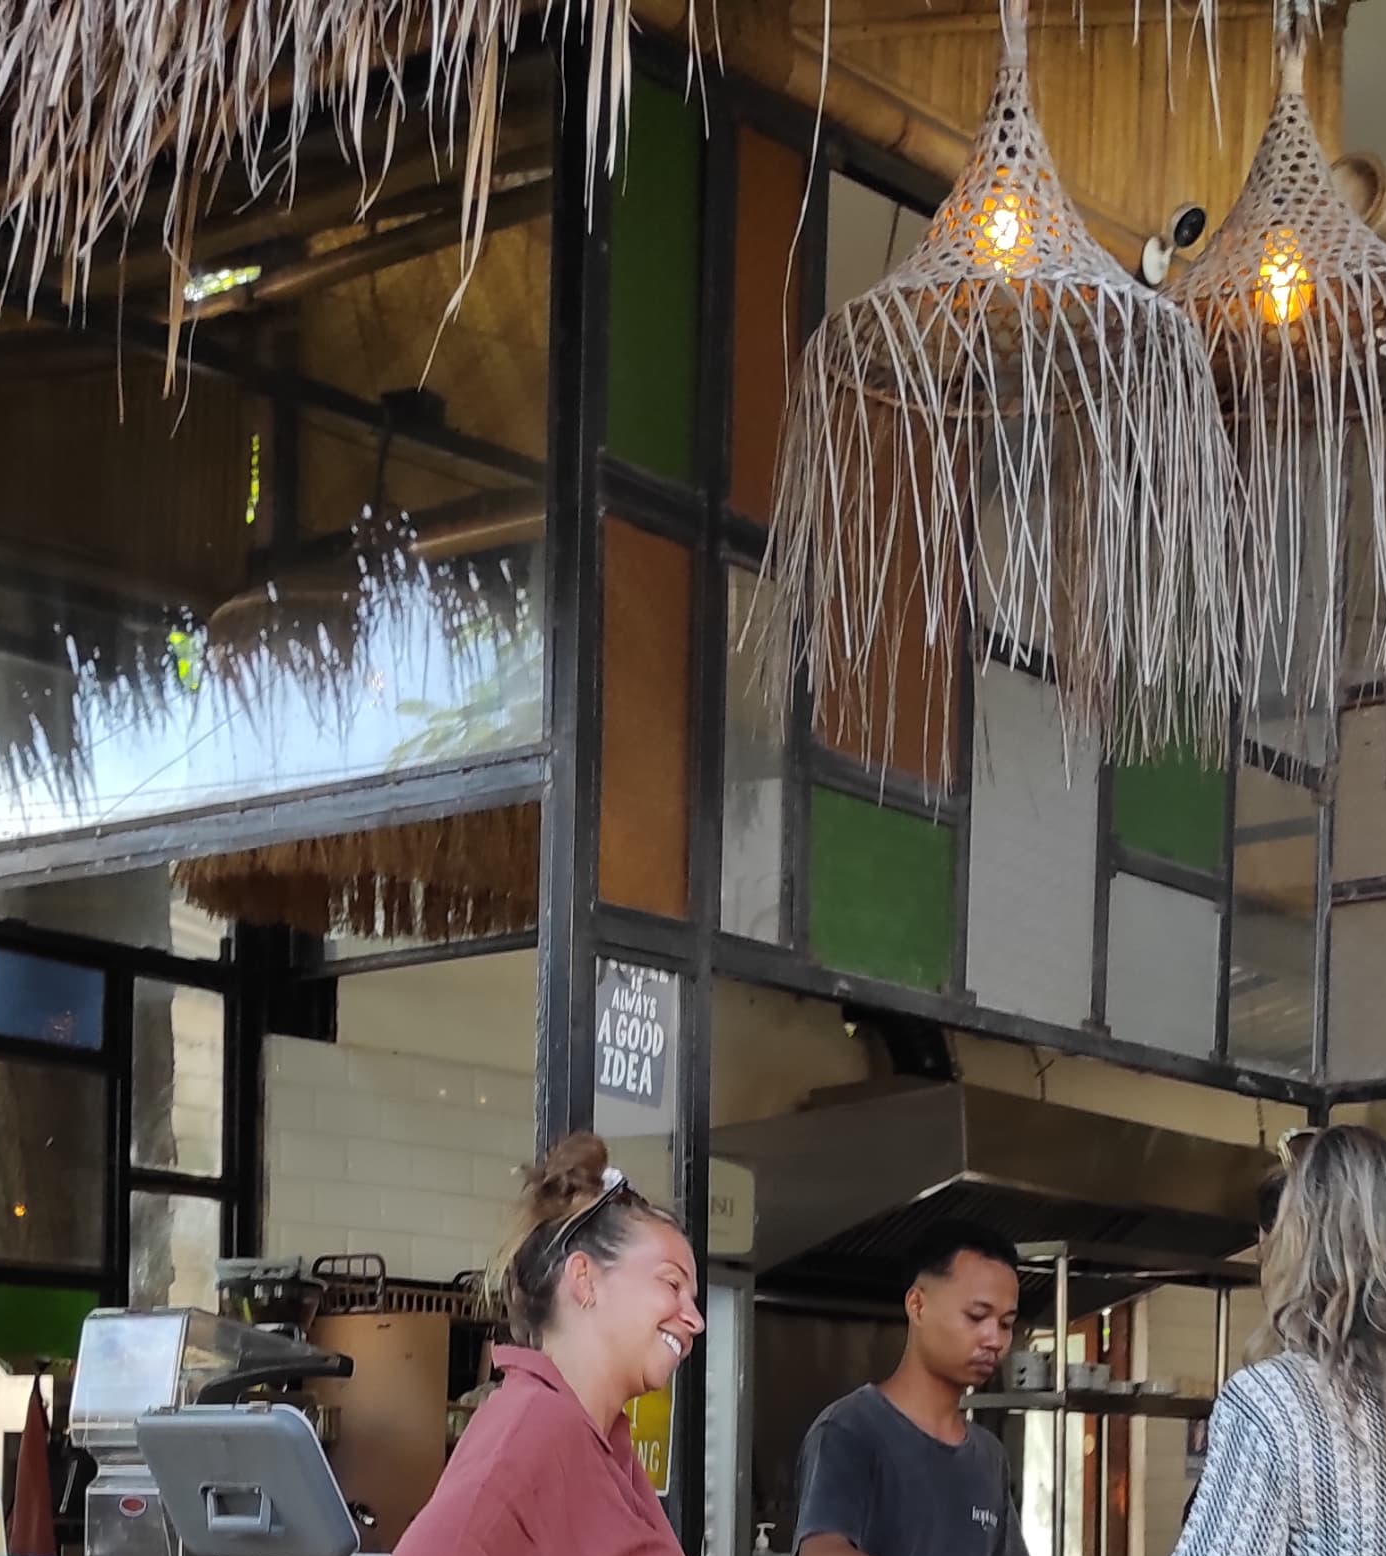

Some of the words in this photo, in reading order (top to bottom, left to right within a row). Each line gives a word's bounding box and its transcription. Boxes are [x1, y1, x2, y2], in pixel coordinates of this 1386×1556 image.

[611, 987, 657, 1019] ALWAYS
[597, 1008, 611, 1044] A
[615, 1013, 664, 1058] GOOD
[599, 1046, 652, 1096] IDEA
